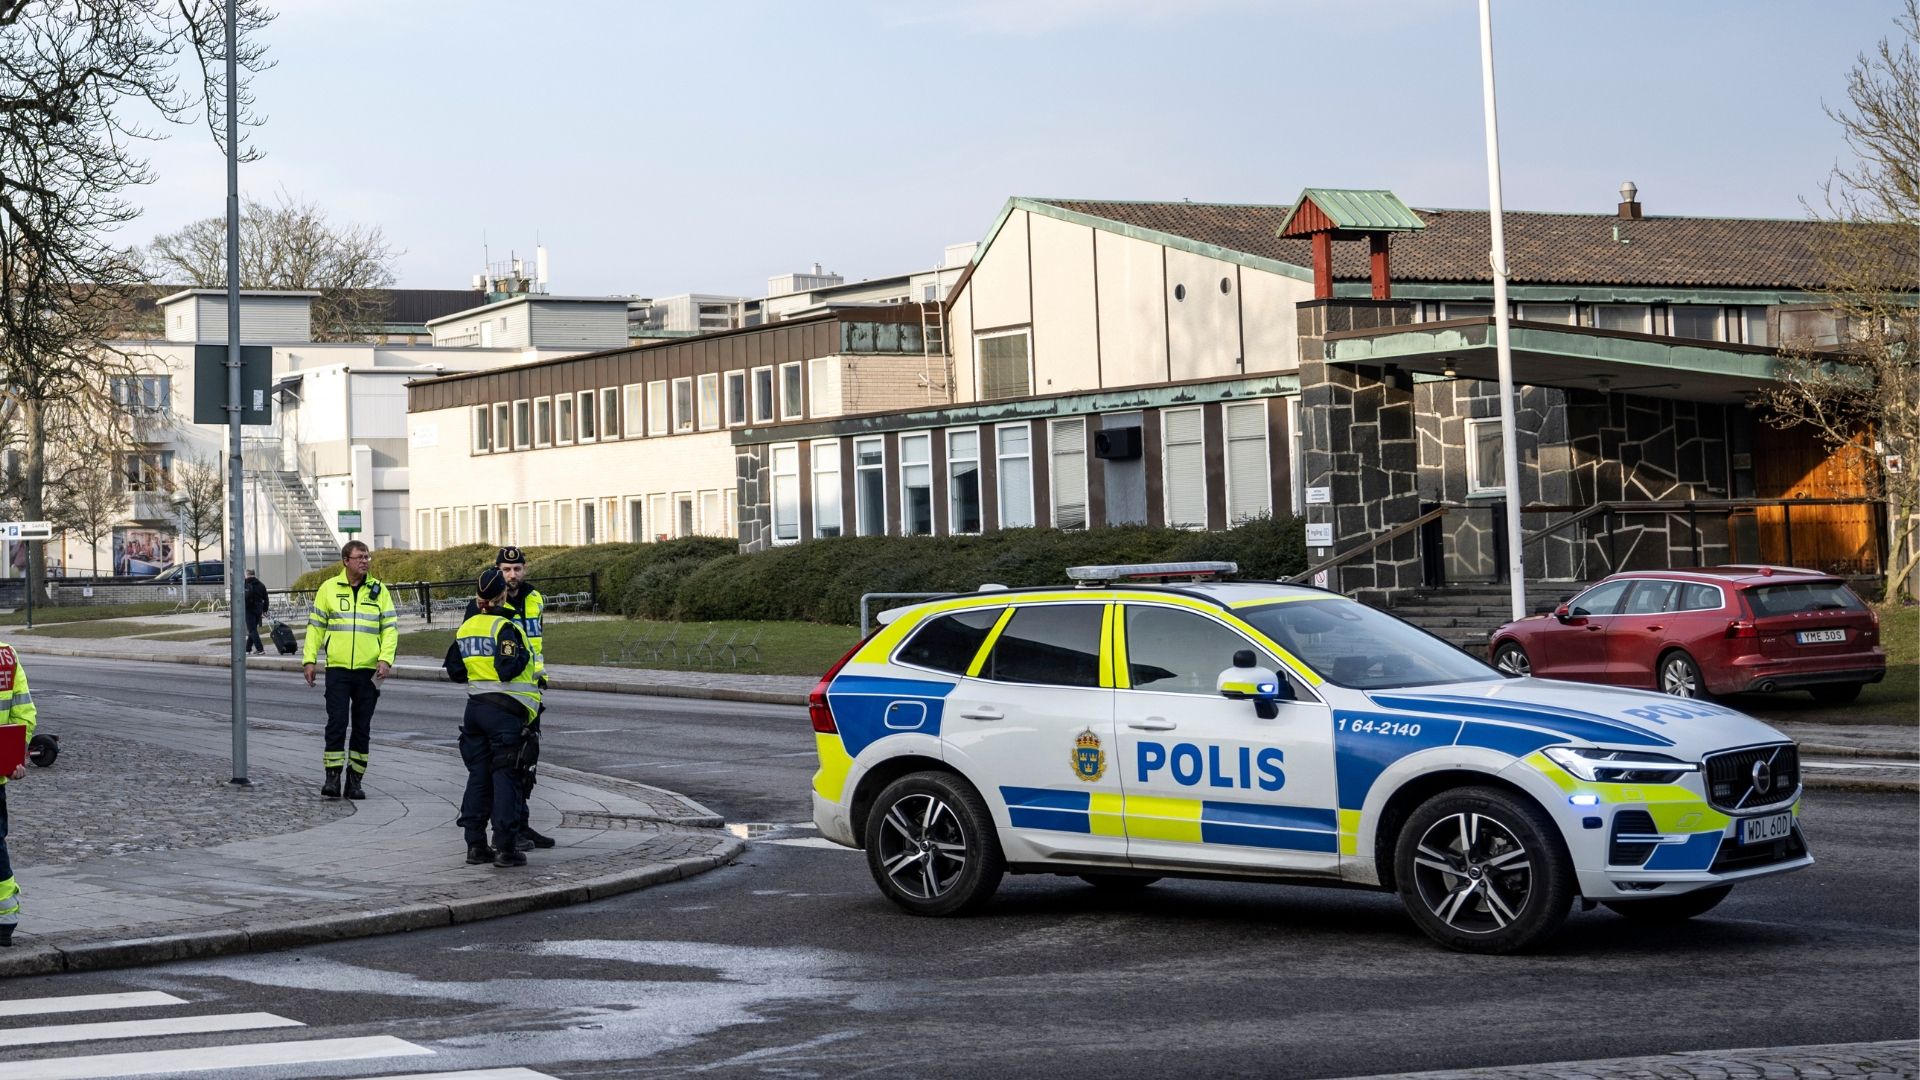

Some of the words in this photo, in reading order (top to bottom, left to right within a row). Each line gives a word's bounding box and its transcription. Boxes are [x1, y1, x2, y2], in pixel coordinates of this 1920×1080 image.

[1804, 631, 1822, 642] YME
[1825, 630, 1842, 641] 30S
[0, 648, 14, 665] TS
[1338, 718, 1347, 731] 1
[1351, 719, 1422, 737] 64-2140
[1136, 741, 1286, 792] POLIS
[1747, 820, 1767, 841] WDL
[1770, 815, 1788, 836] 60D
